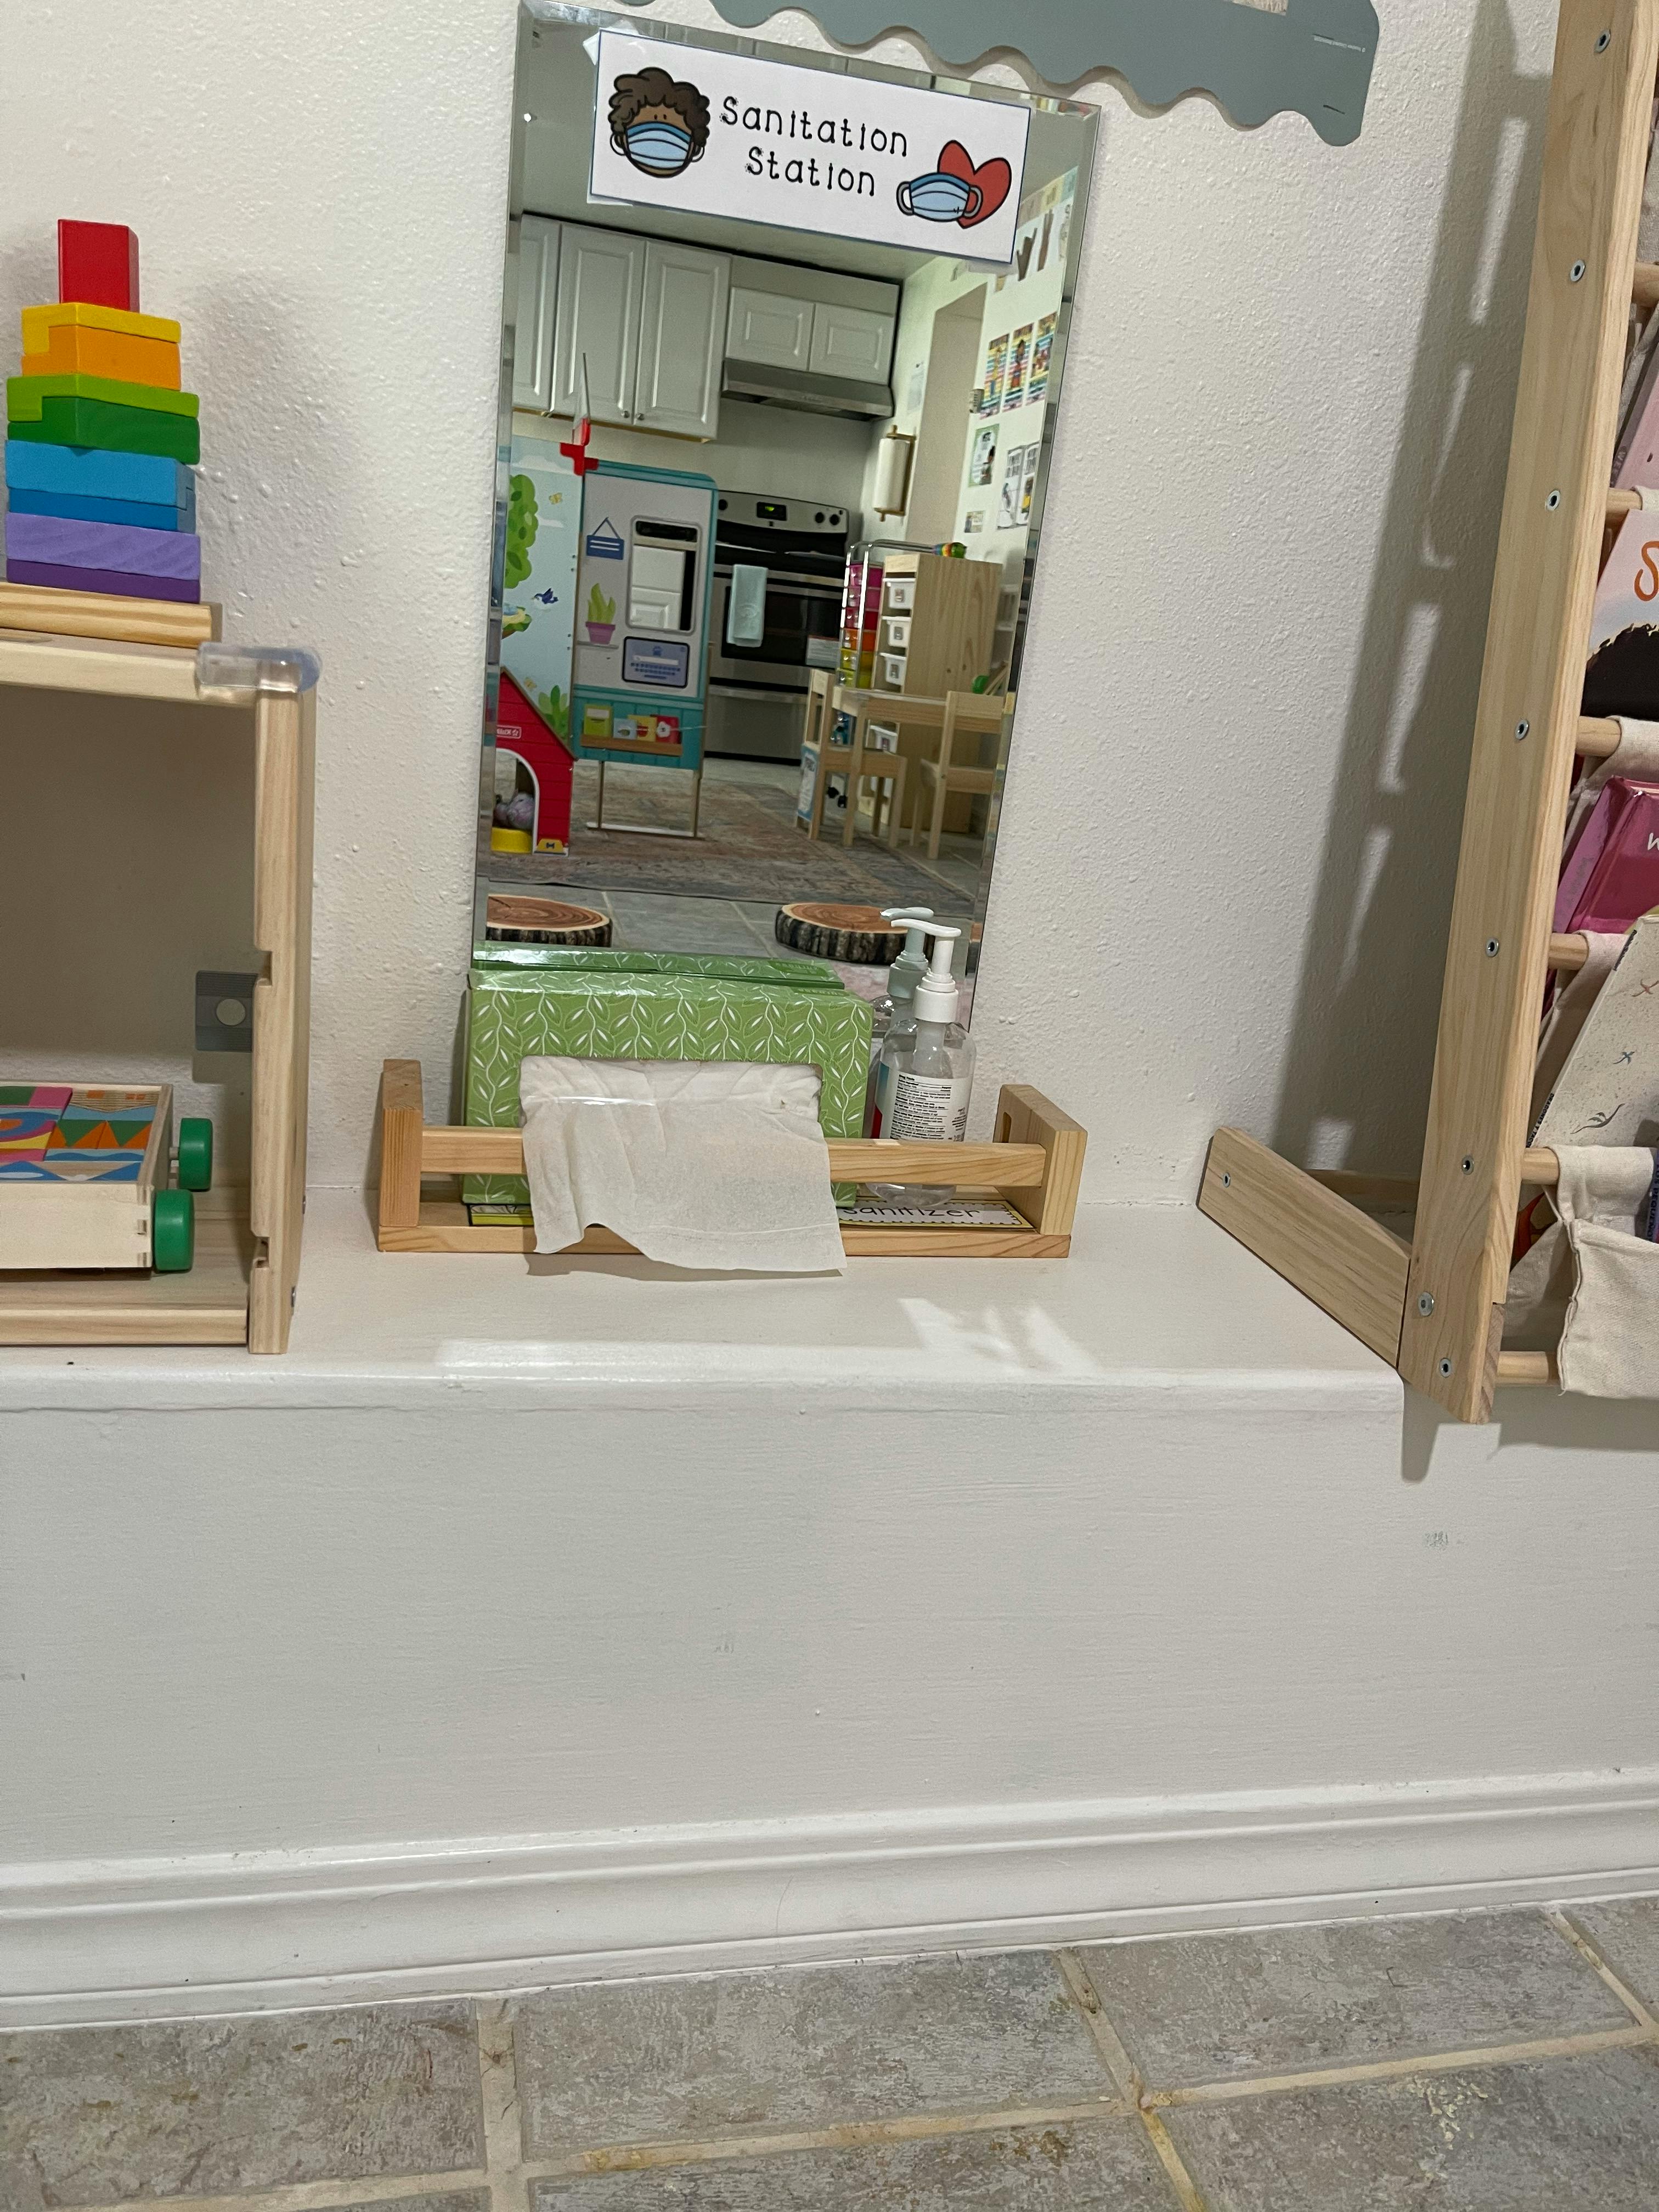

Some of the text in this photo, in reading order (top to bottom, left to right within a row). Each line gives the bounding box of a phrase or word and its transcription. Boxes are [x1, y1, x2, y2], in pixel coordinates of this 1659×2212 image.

[719, 95, 907, 157] Sanitation
[745, 146, 875, 197] Station
[1538, 1093, 1555, 1125] DRAGONES
